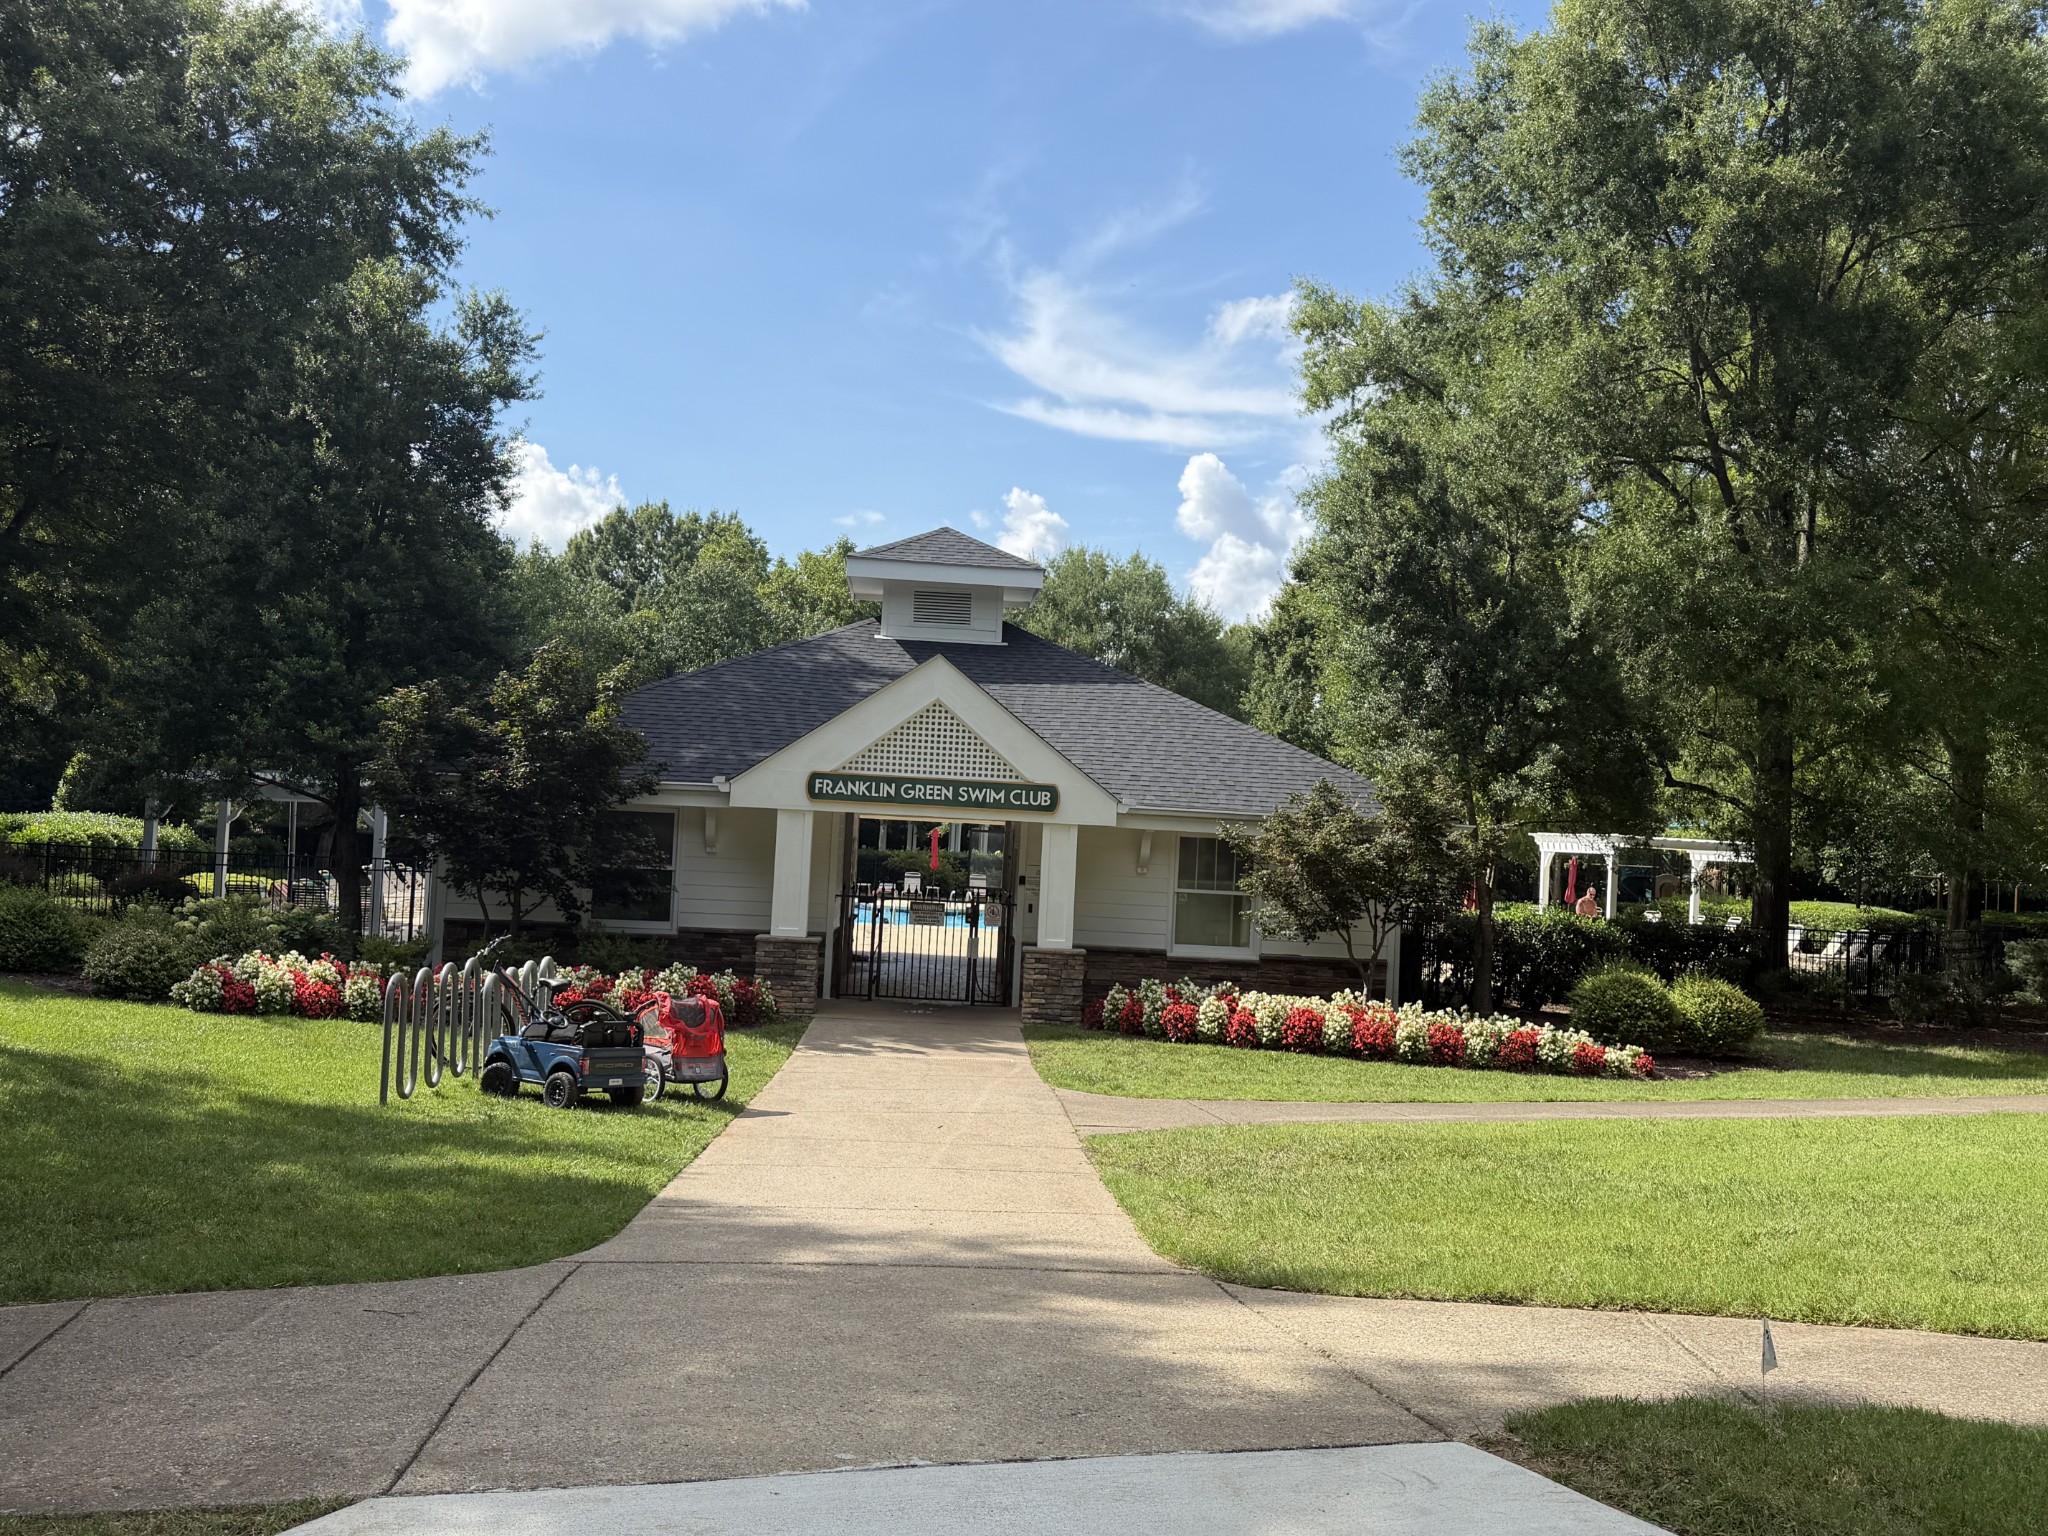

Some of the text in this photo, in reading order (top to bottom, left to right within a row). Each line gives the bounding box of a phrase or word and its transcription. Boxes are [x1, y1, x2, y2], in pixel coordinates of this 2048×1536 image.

[814, 779, 1051, 806] FRANKLIN GREEN SWIM CLUB
[912, 903, 943, 911] WARNING
